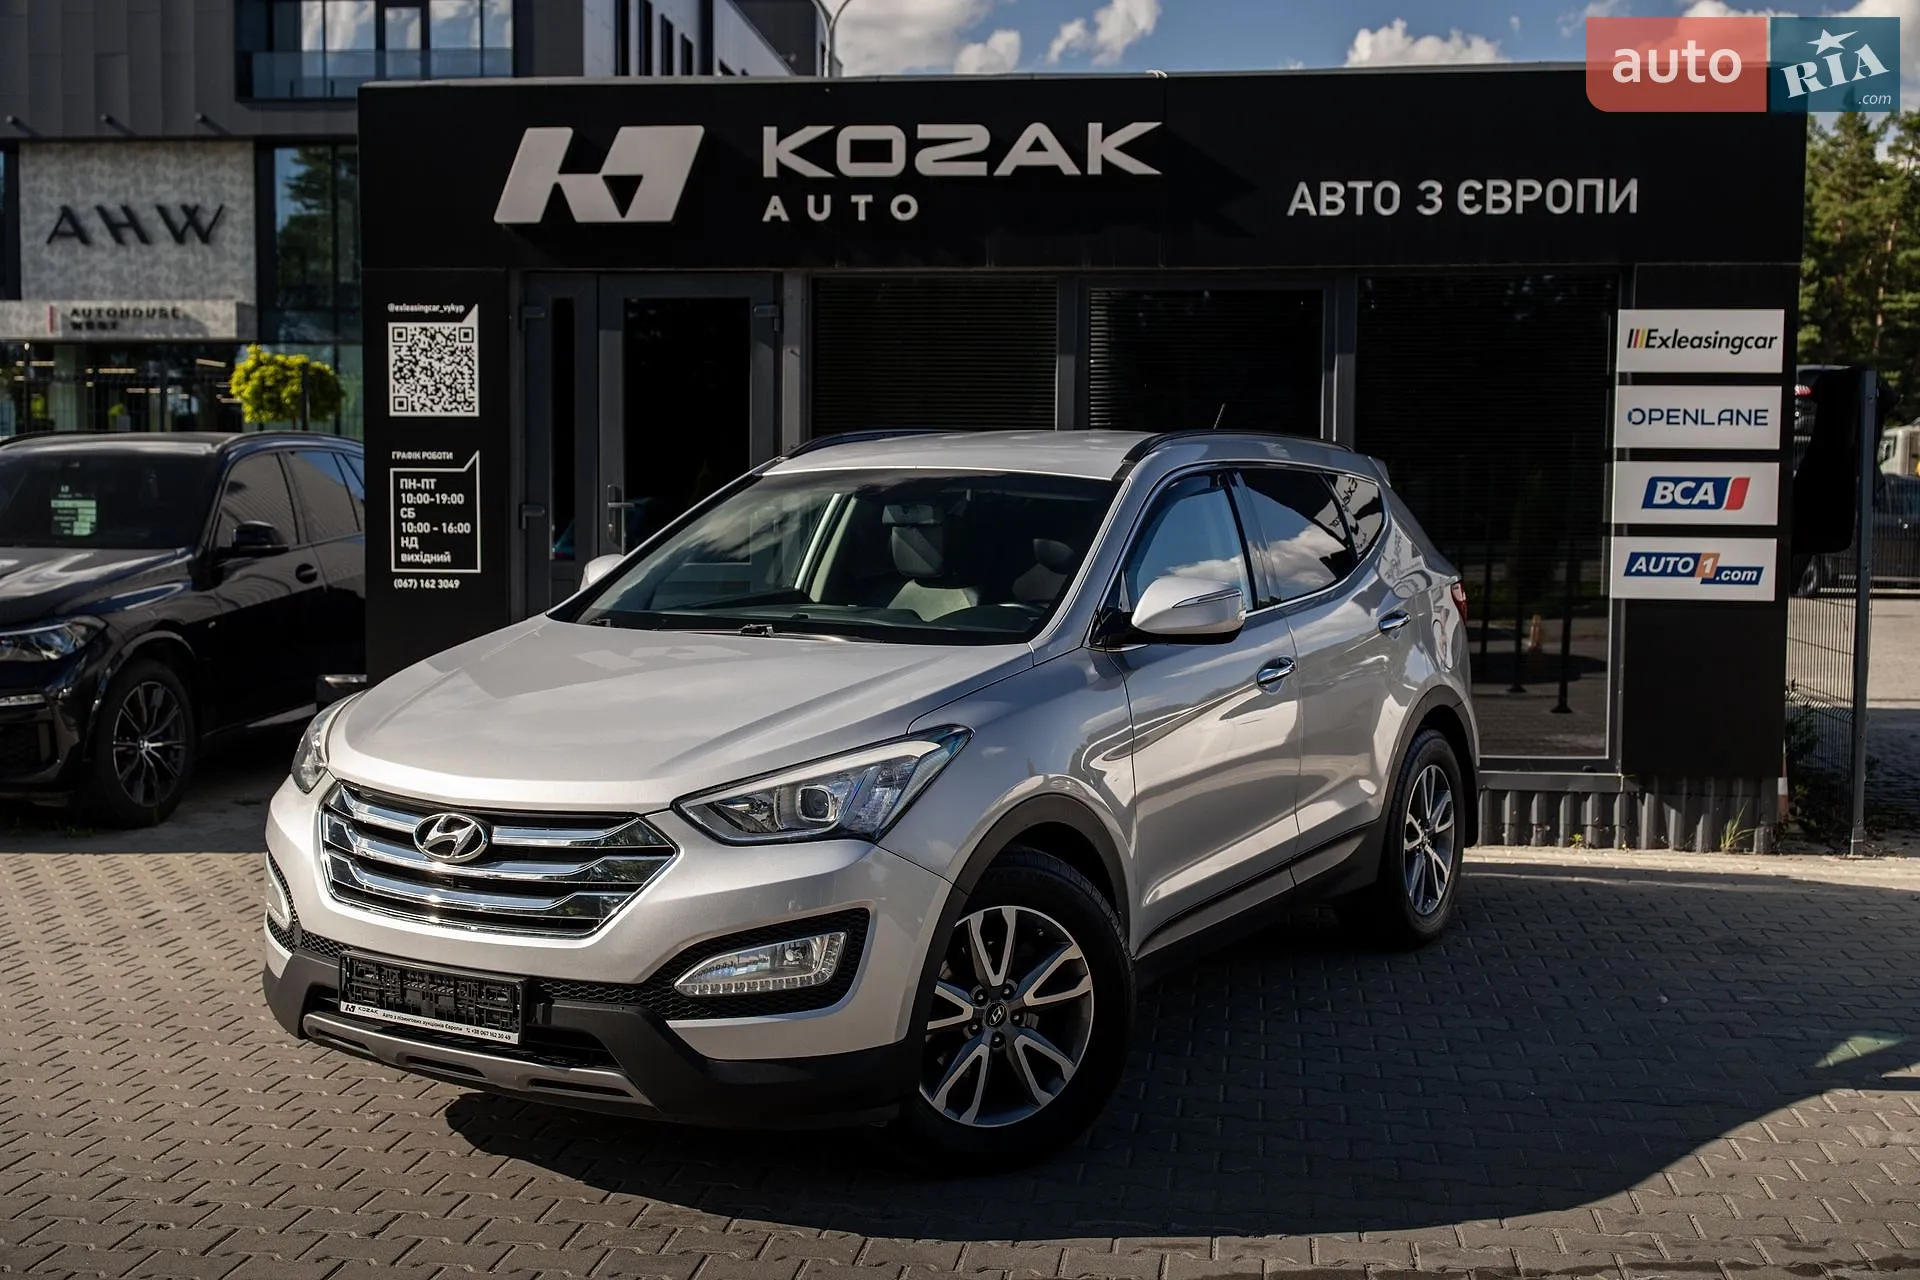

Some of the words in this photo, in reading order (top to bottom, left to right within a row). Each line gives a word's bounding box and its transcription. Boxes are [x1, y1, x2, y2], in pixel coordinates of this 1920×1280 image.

[763, 122, 1162, 177] KOZAK
[1286, 180, 1401, 216] АВТО
[1457, 178, 1638, 215] ЄВРОПИ
[762, 194, 918, 222] AUTO
[46, 204, 226, 245] AHW
[70, 307, 182, 320] AUTOHOUSE
[1645, 328, 1778, 355] Exleasingcar
[1628, 408, 1768, 426] OPENLANE
[391, 451, 421, 460] ГРАФІК
[422, 451, 453, 460] РОБОТИ
[400, 478, 437, 490] ПН-ПТ
[401, 493, 464, 504] 10:00-19:00
[1653, 481, 1716, 505] BCA
[400, 507, 416, 519] СБ
[401, 522, 431, 534] 10:00
[442, 522, 471, 534] 16:00
[400, 536, 419, 549] НД
[400, 551, 452, 563] вихідний
[393, 578, 418, 589] (067)
[420, 579, 436, 588] 162
[438, 579, 460, 588] 3049
